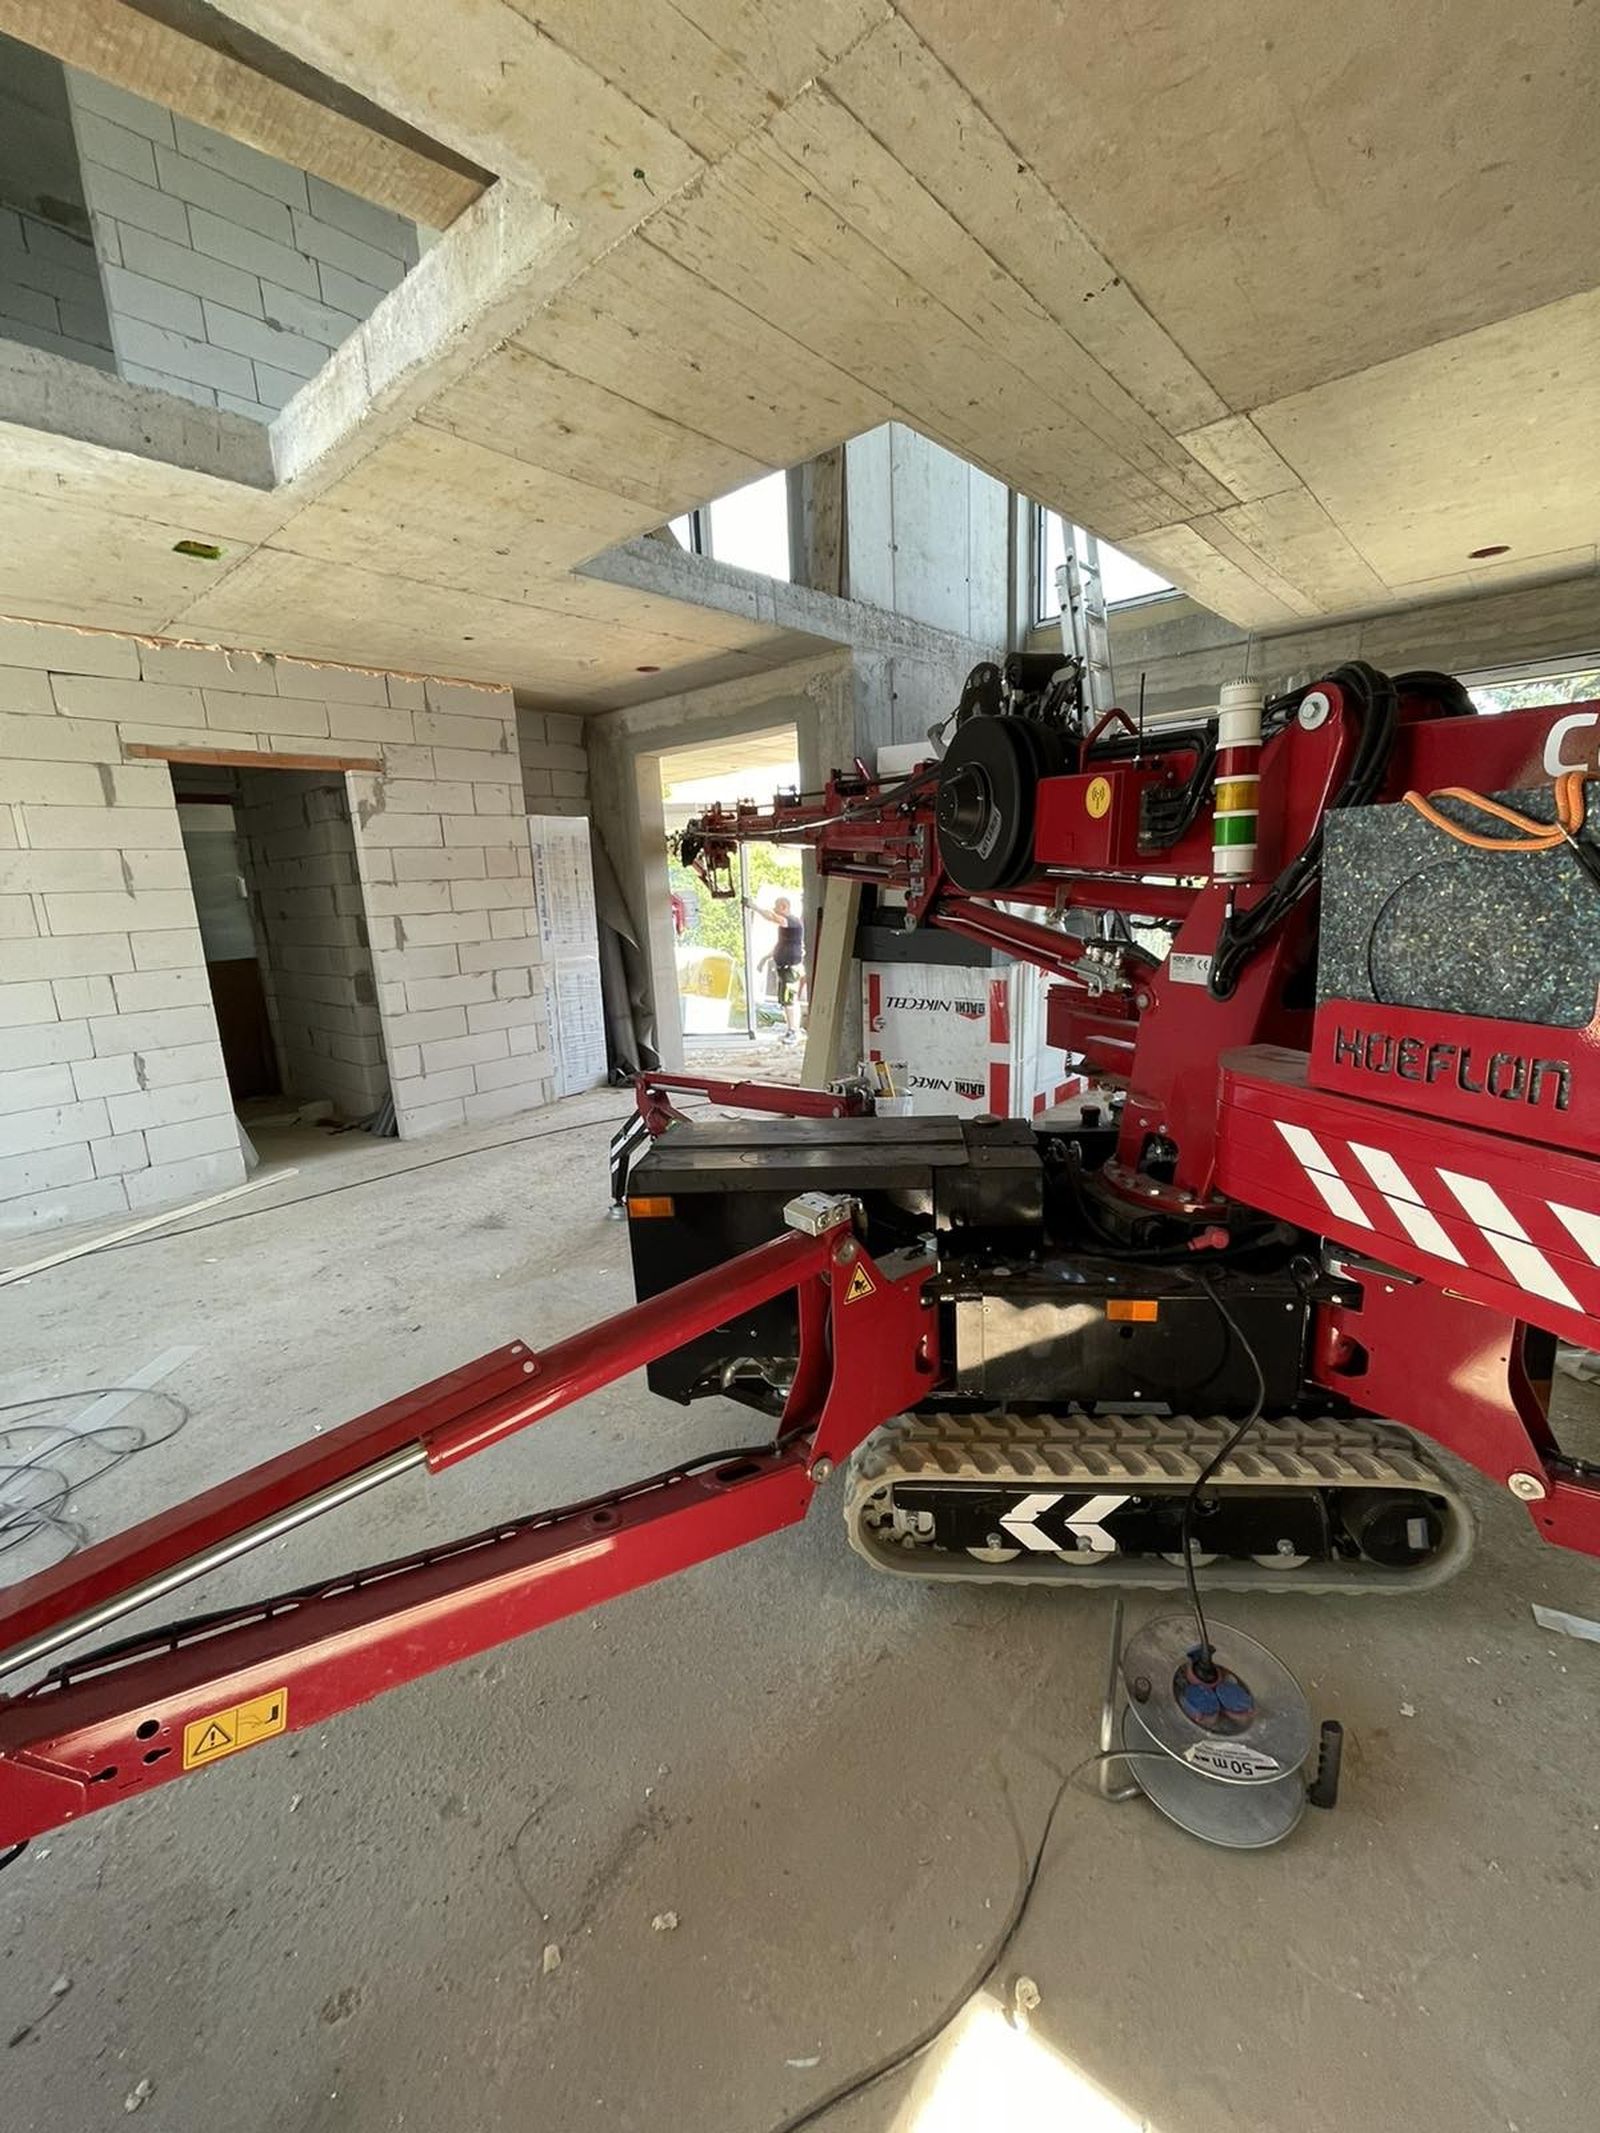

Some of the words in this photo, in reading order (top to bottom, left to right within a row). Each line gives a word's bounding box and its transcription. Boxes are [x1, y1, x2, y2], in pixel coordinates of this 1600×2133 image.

[886, 996, 952, 1012] NIKECELL
[908, 1075, 953, 1091] NIKEC
[1212, 1757, 1228, 1769] m
[1230, 1760, 1254, 1776] 50
